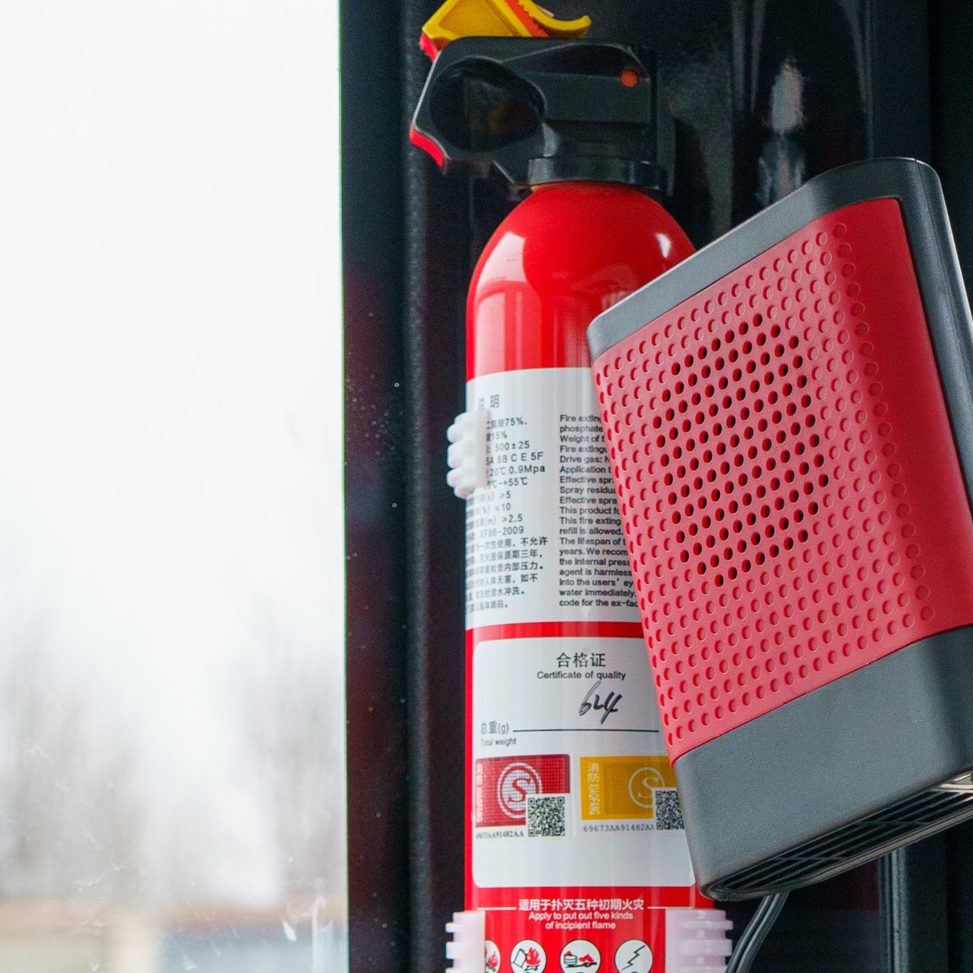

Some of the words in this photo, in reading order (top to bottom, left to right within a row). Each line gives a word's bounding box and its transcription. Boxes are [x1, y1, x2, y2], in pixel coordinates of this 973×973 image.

[560, 414, 576, 422] Fire
[560, 435, 589, 443] Weight
[531, 451, 544, 461] 5F
[560, 455, 582, 463] Drive
[509, 464, 546, 475] 0.9Mpa
[560, 466, 606, 474] Application
[560, 486, 584, 495] Spray
[560, 496, 596, 504] Effective
[579, 507, 612, 515] product
[560, 537, 575, 545] The
[577, 537, 611, 546] lifespan
[612, 537, 621, 545] of
[560, 568, 583, 577] agent
[577, 578, 590, 586] the
[556, 652, 606, 668] 合格证
[537, 671, 582, 679] Certificate
[585, 671, 594, 679] of
[597, 671, 627, 681] quality
[495, 737, 517, 747] weight
[518, 899, 644, 911] 适用于扑灭五种初期火灾
[529, 911, 552, 921] Apply
[553, 911, 561, 920] to
[563, 911, 577, 921] put
[578, 911, 592, 920] out
[594, 911, 609, 920] five
[611, 911, 633, 920] kinds
[545, 921, 554, 930] of
[555, 921, 591, 931] incipient
[592, 921, 616, 930] flame
